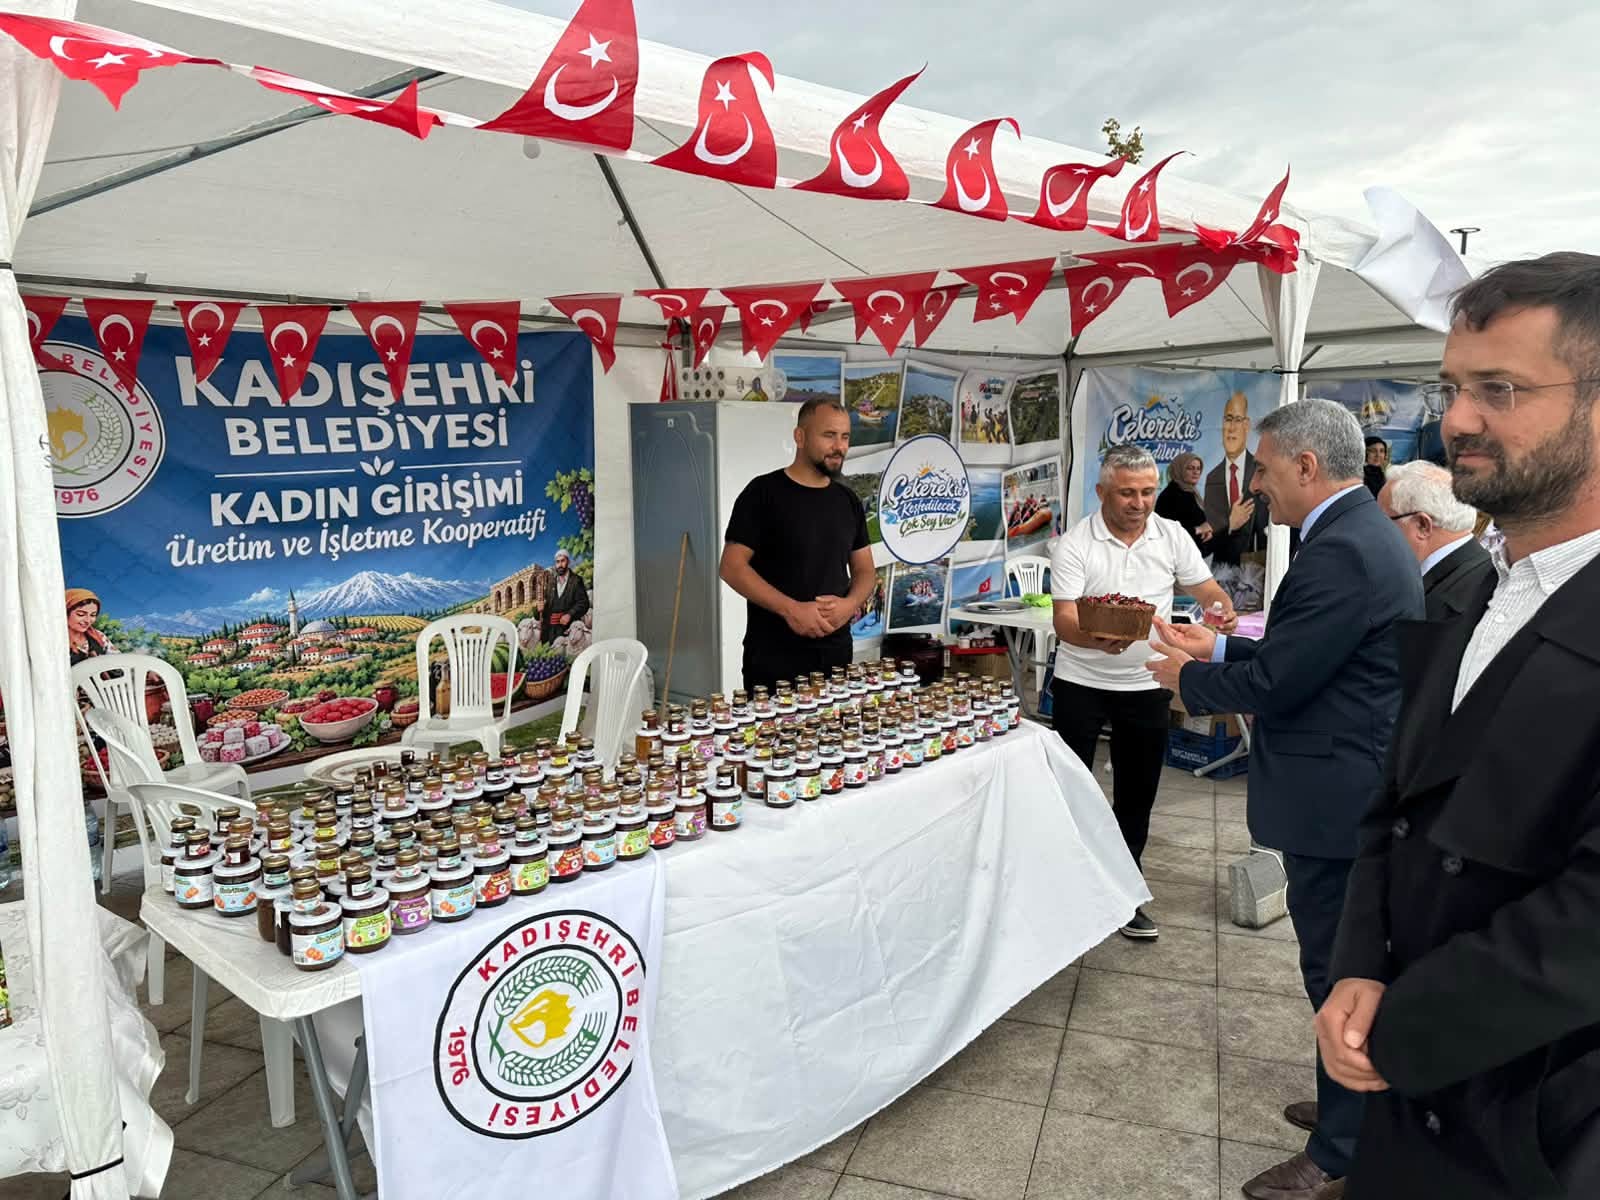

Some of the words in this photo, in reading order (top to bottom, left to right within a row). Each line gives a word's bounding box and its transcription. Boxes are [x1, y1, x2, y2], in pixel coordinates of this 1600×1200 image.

[175, 356, 534, 416] KADIŞEHRİ
[225, 408, 508, 456] BELEDİYESİ
[210, 486, 359, 527] KADIN
[371, 469, 523, 517] GİRİŞİMİ
[165, 532, 275, 568] Üretim
[281, 535, 313, 557] ve
[319, 521, 416, 561] İşletme
[422, 507, 547, 549] Kooperatifi
[477, 919, 638, 982] KADIŞEHRİ
[447, 1026, 470, 1086] 1976
[487, 987, 640, 1126] BELEDİYESİ
